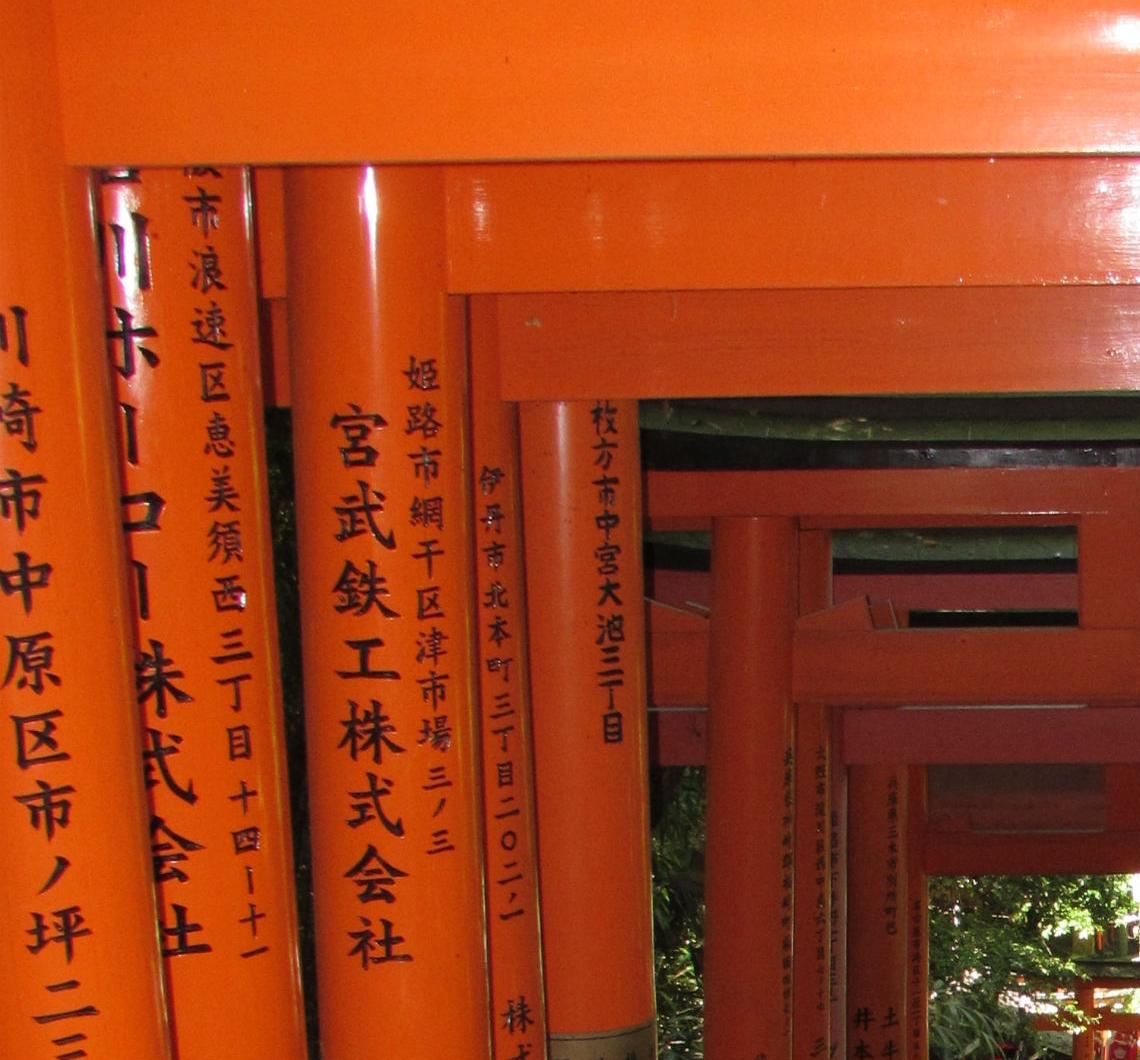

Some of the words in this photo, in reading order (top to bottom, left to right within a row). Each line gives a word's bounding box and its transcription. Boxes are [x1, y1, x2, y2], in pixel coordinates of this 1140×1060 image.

[330, 403, 413, 970] 宮武鉄工株式会社
